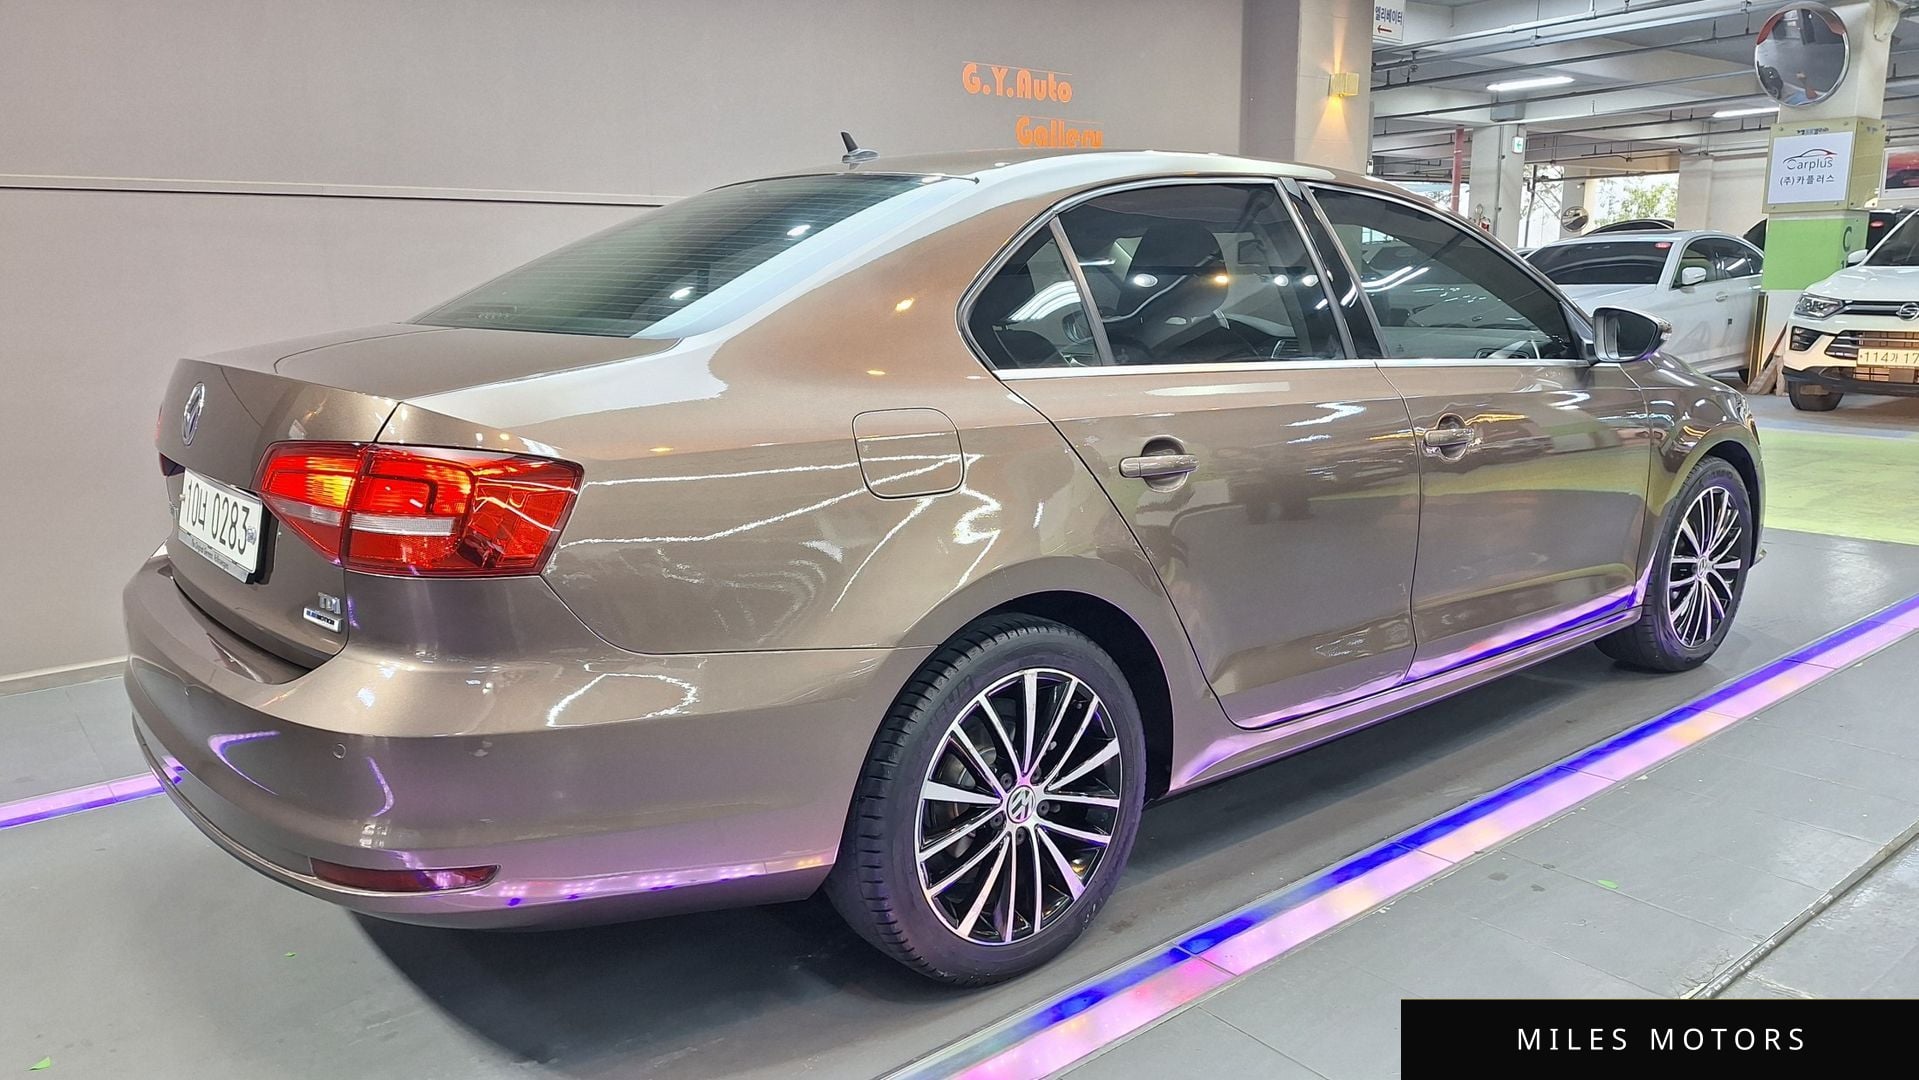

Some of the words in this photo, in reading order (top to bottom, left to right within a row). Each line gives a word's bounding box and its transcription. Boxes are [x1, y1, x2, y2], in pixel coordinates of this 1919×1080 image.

[1375, 6, 1402, 25] 엘리베이터
[962, 62, 1073, 103] G.Y.Auto
[1786, 156, 1834, 171] Carplus
[211, 493, 250, 555] 0283
